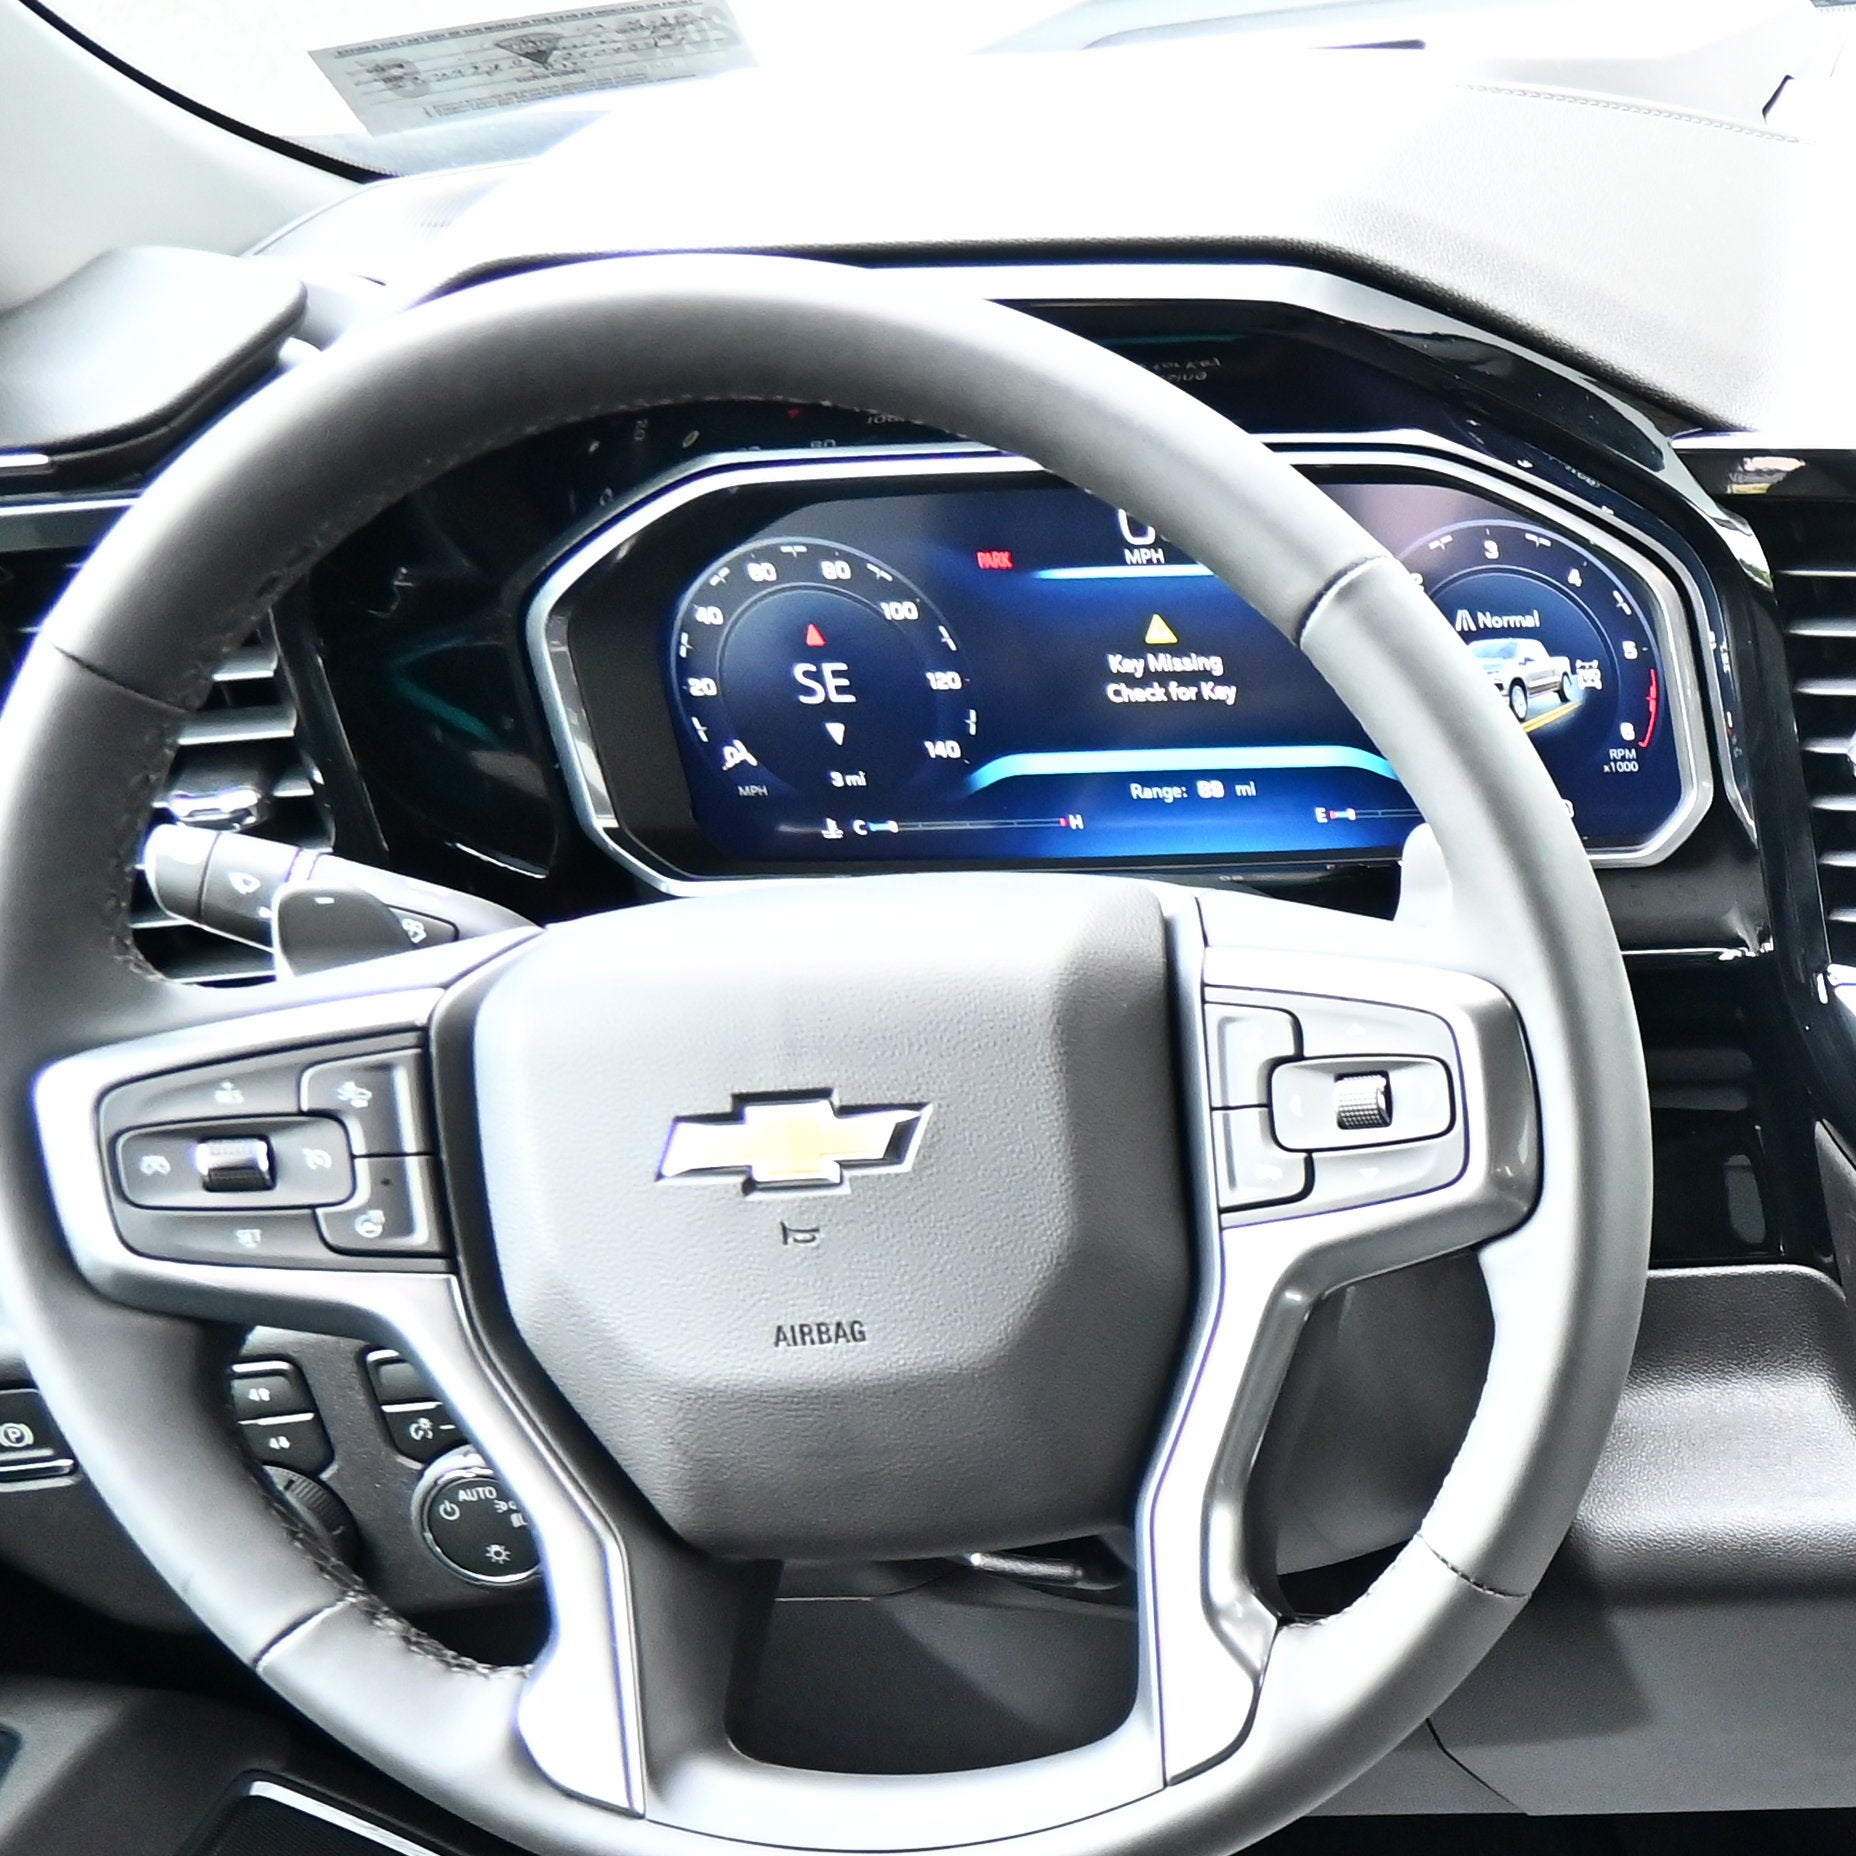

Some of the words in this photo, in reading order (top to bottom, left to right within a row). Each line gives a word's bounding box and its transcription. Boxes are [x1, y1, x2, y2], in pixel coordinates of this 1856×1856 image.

[1124, 548, 1165, 565] MPH
[1484, 540, 1499, 560] 3
[977, 551, 1014, 569] PARK
[1568, 568, 1583, 587] 4
[695, 606, 723, 625] 40
[880, 601, 919, 620] 100
[1477, 610, 1541, 629] Normal
[1622, 640, 1638, 660] 5
[1107, 653, 1145, 679] Key
[1146, 653, 1224, 677] Missing
[687, 678, 717, 697] 20
[793, 662, 856, 704] SE
[926, 671, 962, 690] 120
[1106, 681, 1168, 703] Check
[1168, 681, 1198, 701] for
[1200, 681, 1237, 705] Key
[924, 740, 962, 759] 140
[1609, 749, 1637, 760] RPM
[1603, 761, 1639, 773] x1000
[846, 770, 867, 787] mi
[738, 785, 769, 797] MPH
[1130, 783, 1188, 804] Range:
[1235, 781, 1257, 797] mi
[1068, 814, 1085, 831] H
[1314, 807, 1328, 824] E
[773, 1320, 867, 1348] AIRBAG
[458, 1486, 497, 1501] AUTO
